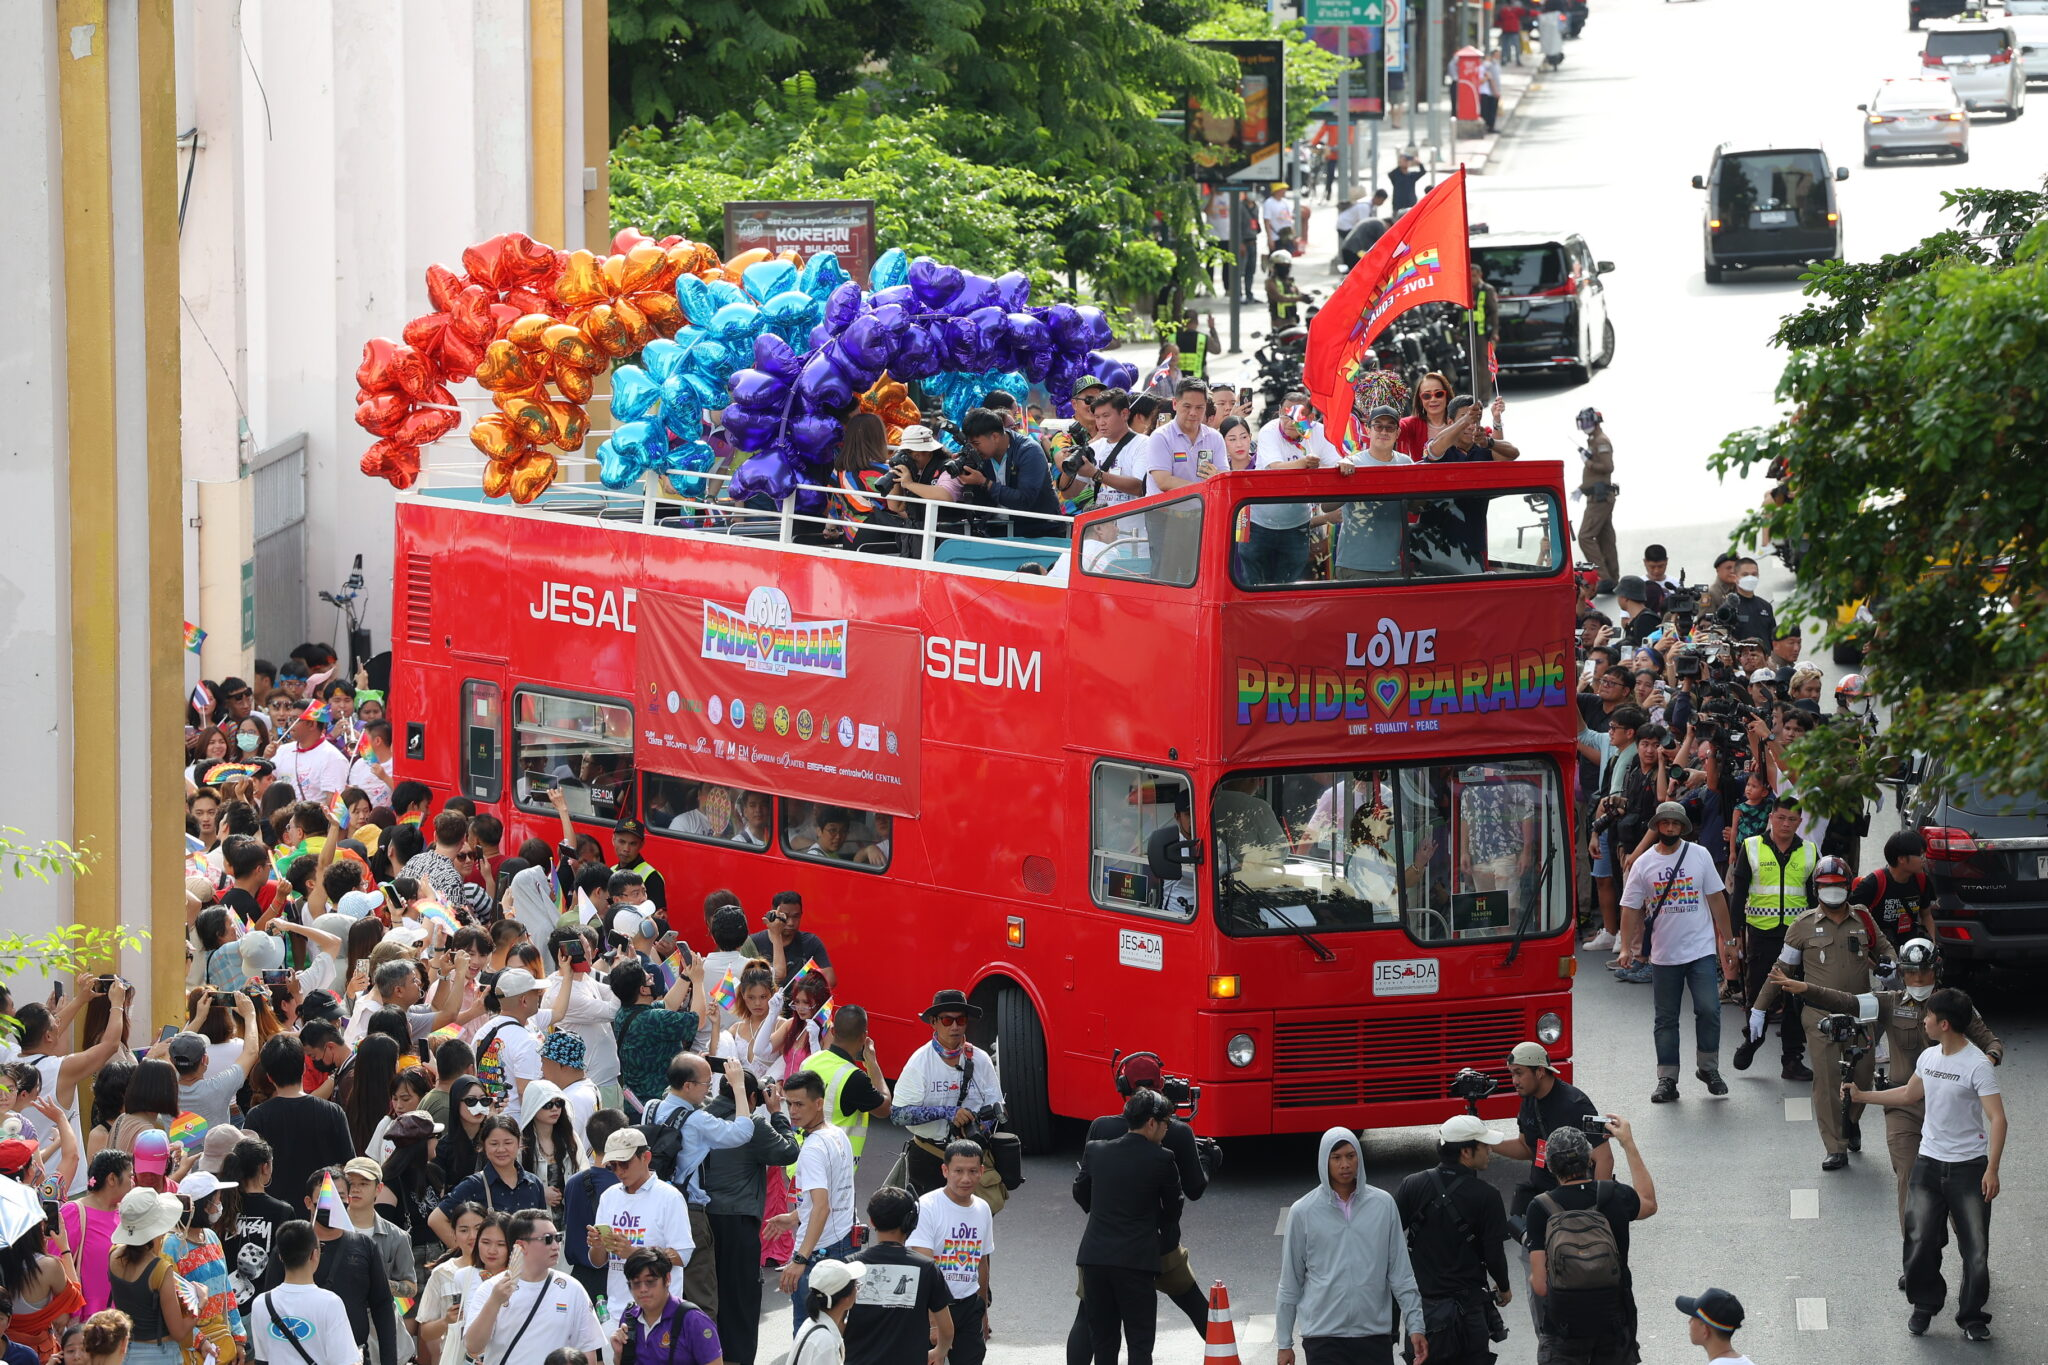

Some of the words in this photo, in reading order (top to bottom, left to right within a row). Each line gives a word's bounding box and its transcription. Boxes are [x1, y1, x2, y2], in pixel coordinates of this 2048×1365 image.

[776, 227, 850, 242] KOREAN
[805, 244, 850, 254] BULGOGI
[749, 591, 788, 628] LOVE
[706, 605, 758, 658] PRIDE
[773, 624, 844, 671] PARADE
[1345, 617, 1437, 667] LOVE
[1236, 655, 1369, 725] PRIDE
[1408, 639, 1569, 716] PARADE
[1348, 725, 1368, 735] LOVE
[1375, 721, 1408, 734] EQUALITY
[1416, 720, 1439, 731] PEACE
[738, 744, 749, 757] EM
[875, 773, 902, 785] CENTRAL
[1120, 934, 1161, 955] JESADA
[1375, 963, 1437, 981] JESADA
[612, 1210, 641, 1228] LOVE
[951, 1222, 978, 1239] LOVE
